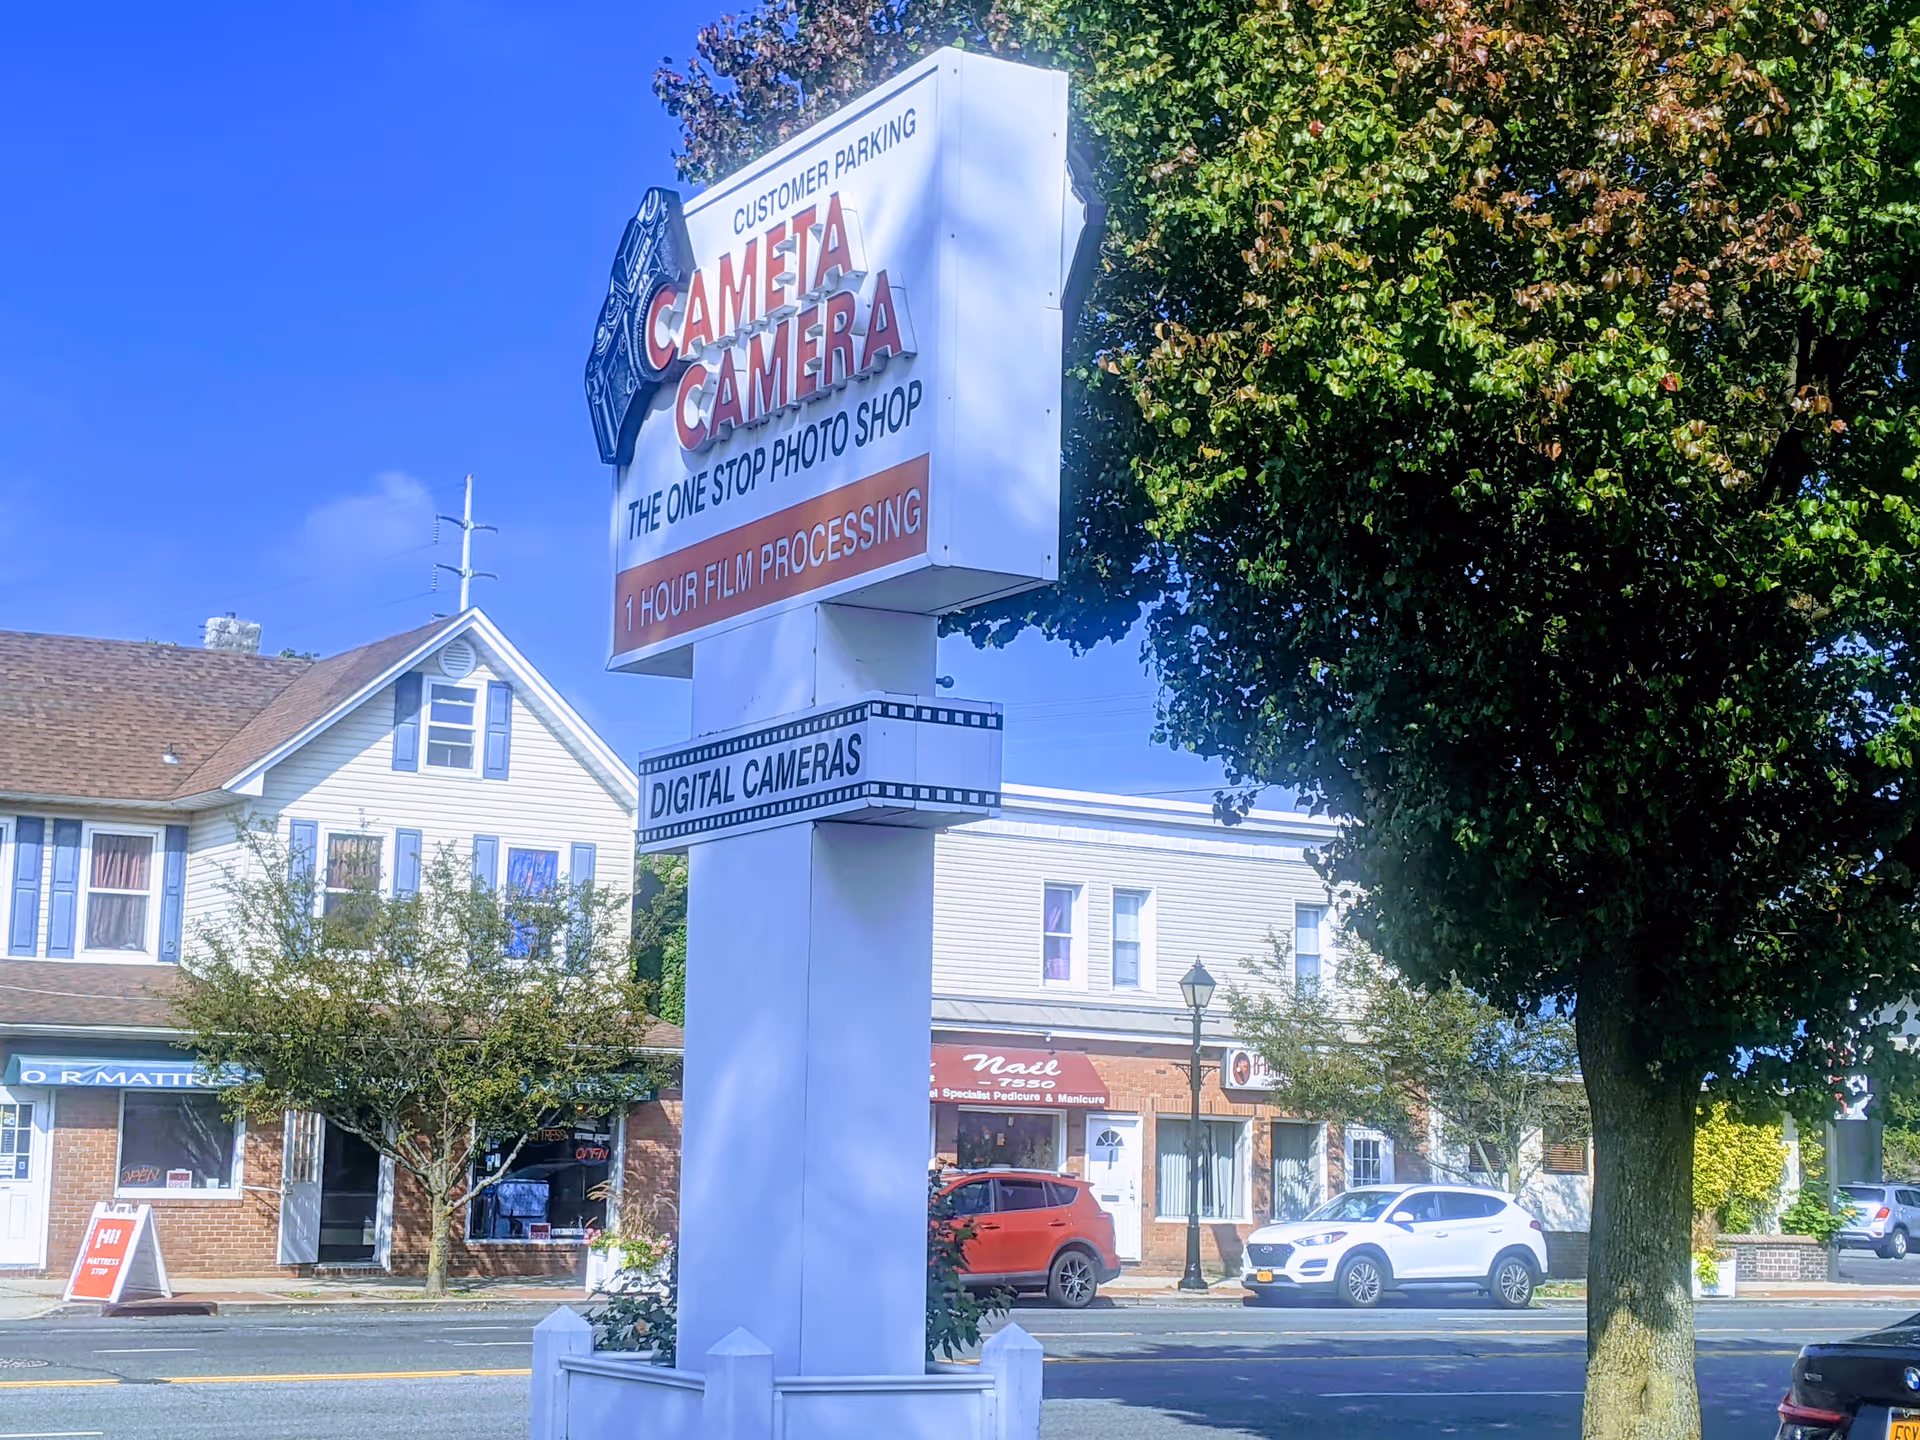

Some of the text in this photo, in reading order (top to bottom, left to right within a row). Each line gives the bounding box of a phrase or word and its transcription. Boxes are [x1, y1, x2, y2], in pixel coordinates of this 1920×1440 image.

[734, 108, 917, 235] CUSTOMER PARKING
[629, 237, 652, 293] CAMETA
[648, 191, 854, 371] CAMETA
[675, 269, 902, 451] CAMERA
[628, 379, 923, 541] THE ONE STOP PHOTO SHOP
[625, 488, 922, 631] 1 HOUR FILM PROCESSING
[650, 733, 862, 820] DIGITAL CAMERAS
[963, 1053, 1062, 1076] Nail
[997, 1078, 1056, 1088] 7550
[943, 1088, 990, 1100] Specialist
[994, 1091, 1040, 1101] Pedicure
[1045, 1093, 1053, 1102] &
[1057, 1094, 1106, 1104] Manicure
[528, 1129, 566, 1142] ATTRESS
[121, 1168, 159, 1184] OPEN
[86, 1257, 120, 1266] MATTRESS
[90, 1267, 109, 1276] STOP
